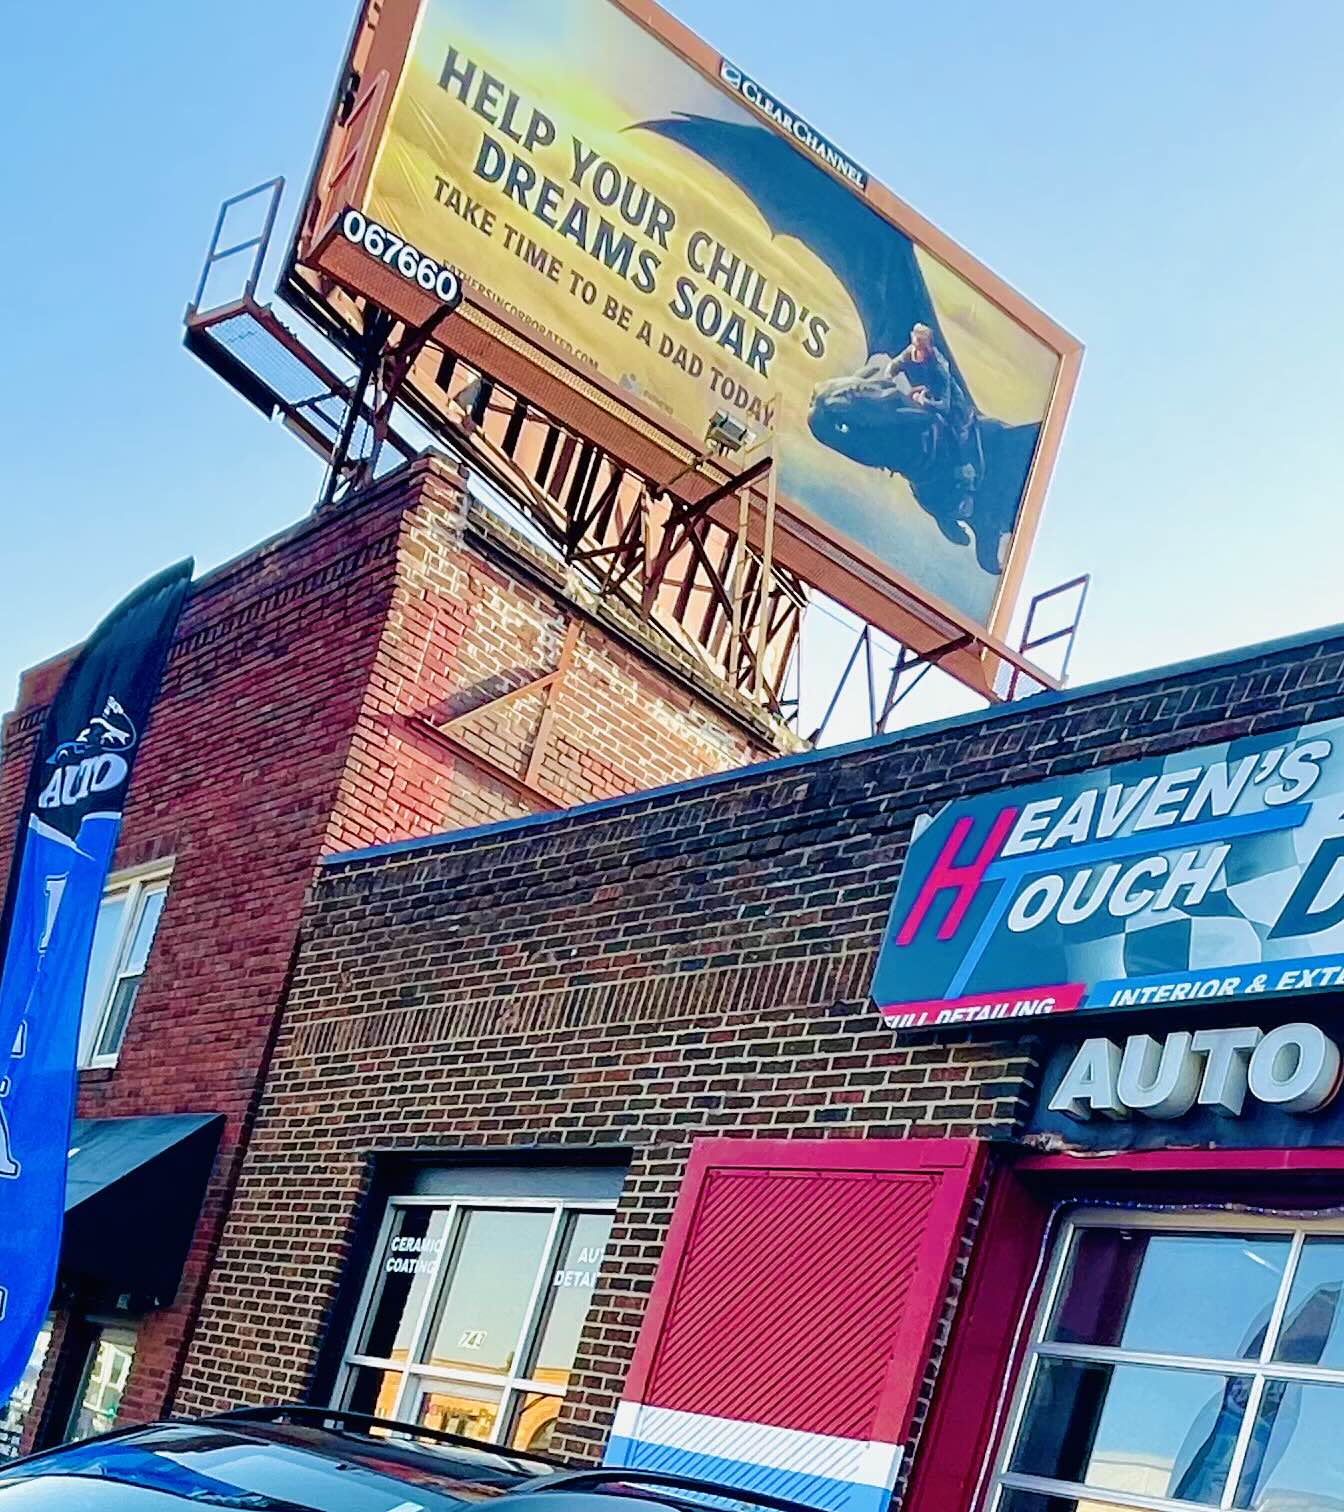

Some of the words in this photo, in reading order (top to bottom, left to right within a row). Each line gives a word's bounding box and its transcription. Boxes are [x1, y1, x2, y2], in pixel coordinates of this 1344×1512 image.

[343, 210, 459, 302] 067660
[434, 175, 497, 237] TAKE
[503, 223, 564, 284] TIME
[569, 270, 597, 305] TO
[602, 295, 633, 331] BE
[636, 320, 652, 347] A
[658, 332, 704, 378] DAD
[437, 45, 556, 153] HELP
[569, 135, 676, 250] YOUR
[687, 231, 830, 359] CHILD'S
[473, 131, 661, 294] DREAMS
[669, 276, 776, 379] SOAR
[895, 739, 1333, 946] HEAVEN'S
[1109, 976, 1240, 1008] INTERIOR
[1244, 974, 1268, 995] &
[391, 1236, 440, 1252] CERAMIC
